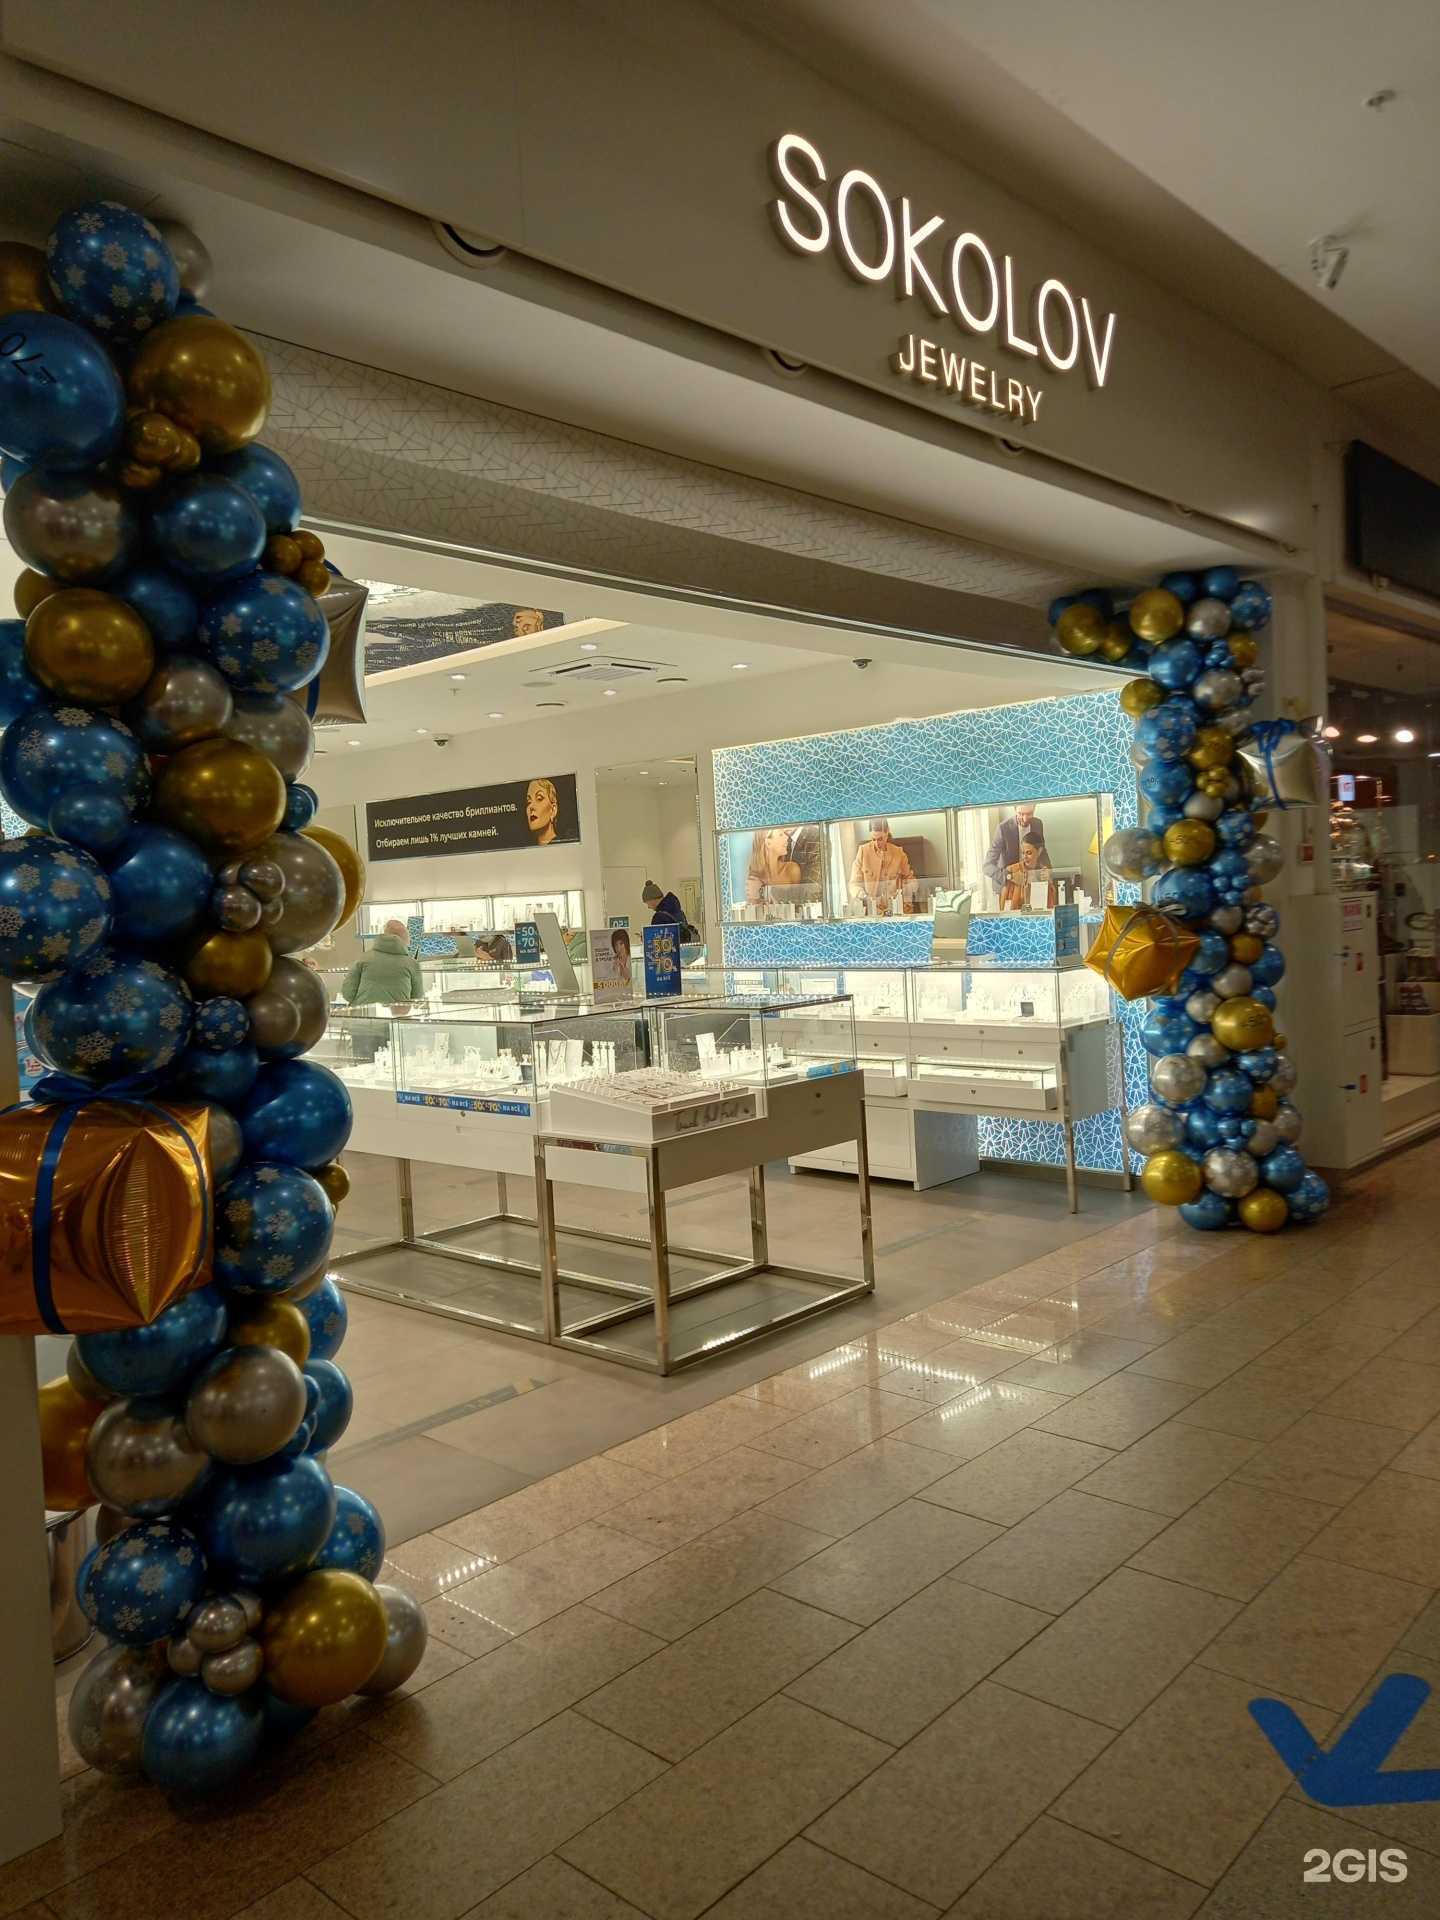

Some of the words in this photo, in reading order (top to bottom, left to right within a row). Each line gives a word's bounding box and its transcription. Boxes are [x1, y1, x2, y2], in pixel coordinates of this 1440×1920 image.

[777, 133, 1115, 387] SOKOLOV
[898, 334, 1042, 421] JEWELRY
[374, 814, 431, 828] Исключительное
[432, 810, 464, 821] качество
[465, 803, 518, 818] бриллиантов.
[376, 838, 409, 848] Отбираем
[410, 835, 429, 845] лишь
[430, 833, 439, 843] 1%
[440, 831, 467, 843] лучших
[468, 826, 499, 839] камней.
